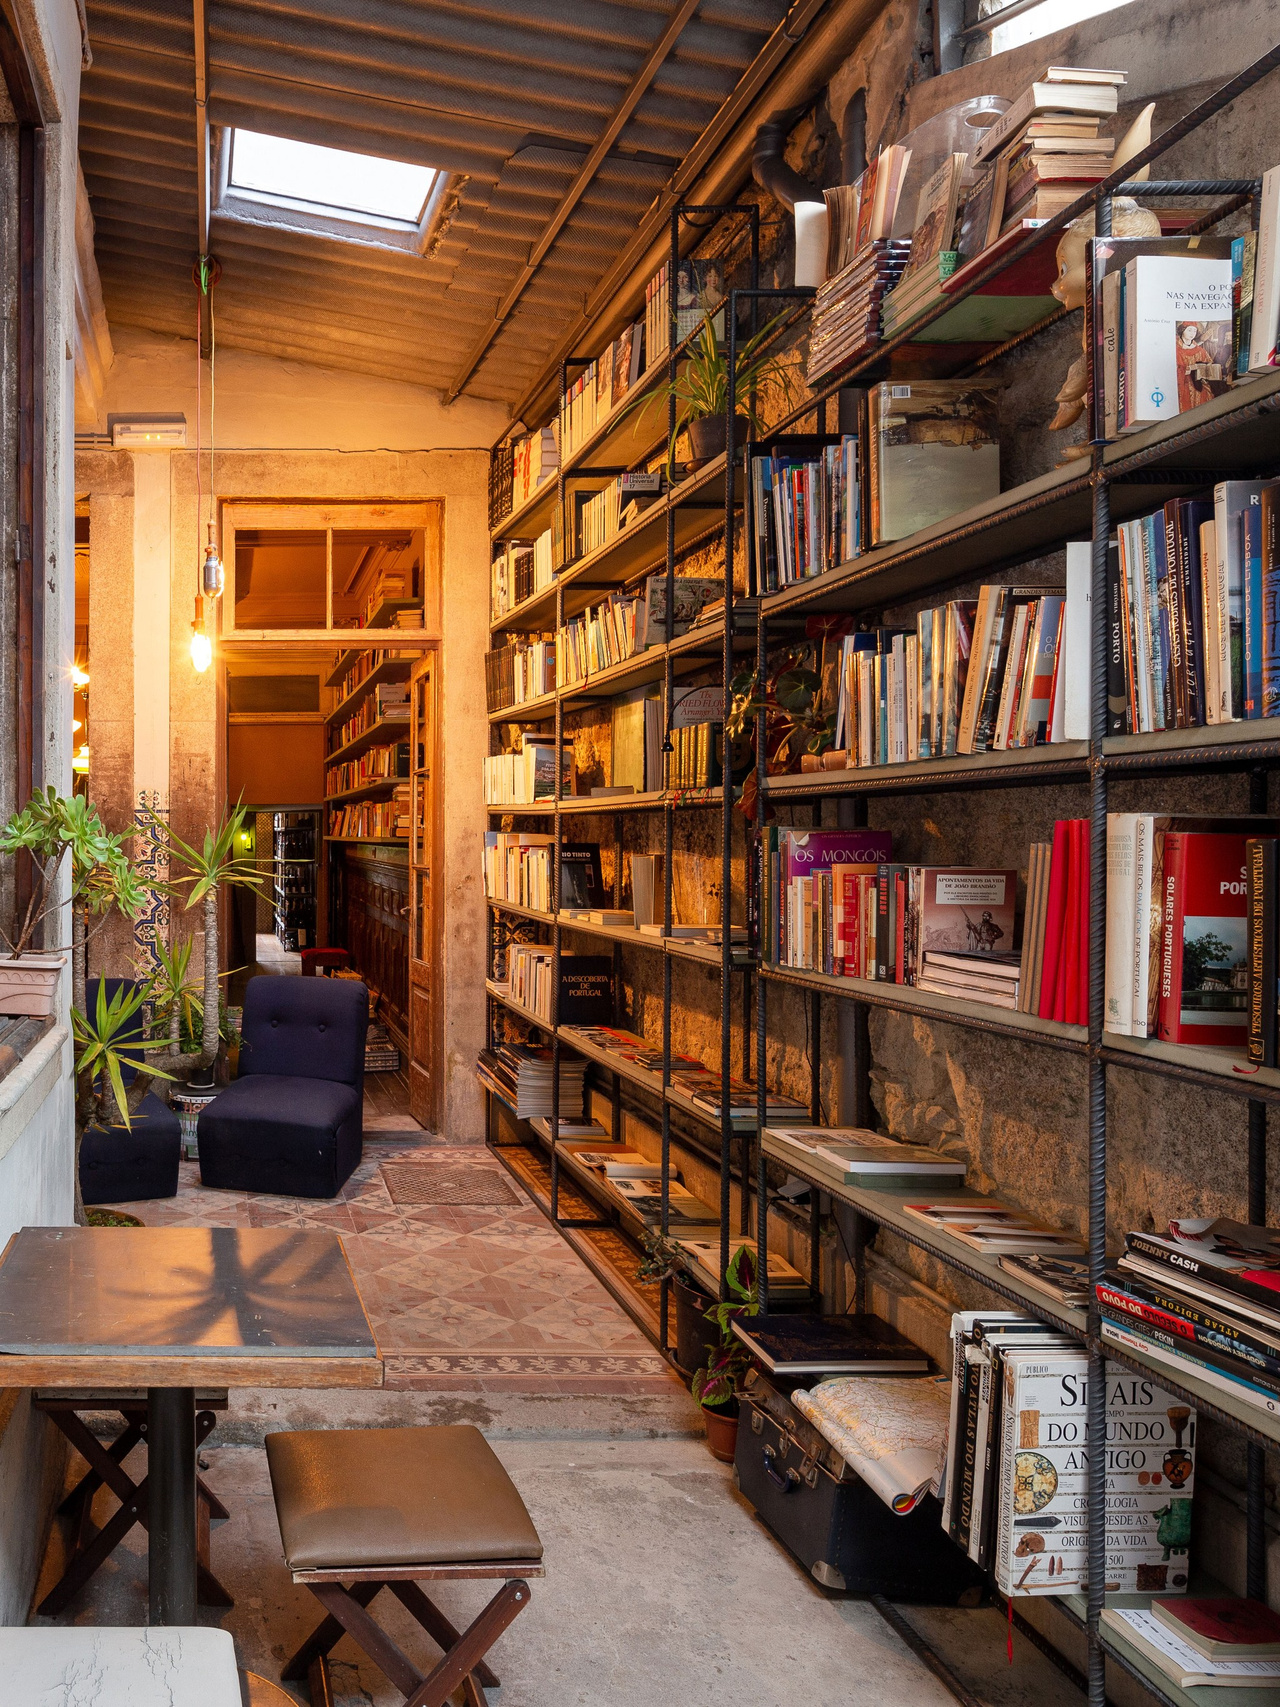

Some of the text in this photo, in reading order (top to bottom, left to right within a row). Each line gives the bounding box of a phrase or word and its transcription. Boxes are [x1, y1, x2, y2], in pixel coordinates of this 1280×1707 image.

[1166, 292, 1184, 300] NAS
[1208, 284, 1216, 292] O
[1184, 302, 1198, 310] NA
[1118, 371, 1126, 412] PORTO
[1165, 520, 1177, 572] PORTUGAL
[1168, 574, 1178, 589] DE
[1217, 560, 1226, 617] PORTUGAL
[1244, 586, 1250, 602] DE
[1112, 622, 1120, 664] PORTO
[1172, 632, 1181, 668] CASAS
[700, 690, 712, 699] The
[1138, 822, 1146, 836] OS
[795, 847, 887, 862] OS MONGÓIS
[1138, 836, 1146, 862] MAIS
[1253, 845, 1264, 898] PORTUGAL
[880, 878, 888, 915] ESTALINE
[1220, 882, 1248, 895] POR
[1136, 892, 1144, 935] PALÁCIOS
[1254, 899, 1264, 918] DE
[1162, 876, 1176, 998] SOLARES PORTUGUESES
[569, 989, 602, 997] PORTUGAL
[580, 982, 590, 990] DE
[1252, 981, 1263, 1034] TESOUROS
[1131, 1238, 1170, 1260] JOHNNY
[1170, 1254, 1200, 1273] CASH
[1102, 1292, 1127, 1309] POVO
[1128, 1302, 1143, 1316] DO
[1097, 1306, 1108, 1316] LES
[1108, 1310, 1134, 1328] GRANDES
[1154, 1296, 1240, 1338] ATLAS EDITORA
[973, 1328, 982, 1339] O
[1180, 1325, 1188, 1335] O
[1139, 1343, 1149, 1352] Guy
[1060, 1374, 1154, 1406] SIAIS
[966, 1389, 978, 1438] ATLAS
[1104, 1410, 1124, 1418] EMPO
[1047, 1422, 1078, 1442] DO
[964, 1441, 974, 1465] DO
[1064, 1450, 1146, 1470] ANIGO
[960, 1468, 972, 1528] MUNDO
[1000, 1413, 1015, 1565] SINAIS DO TEMPO DO MUNDO ANTIGO
[1136, 1514, 1148, 1526] AS
[1106, 1535, 1148, 1546] DA VIDA
